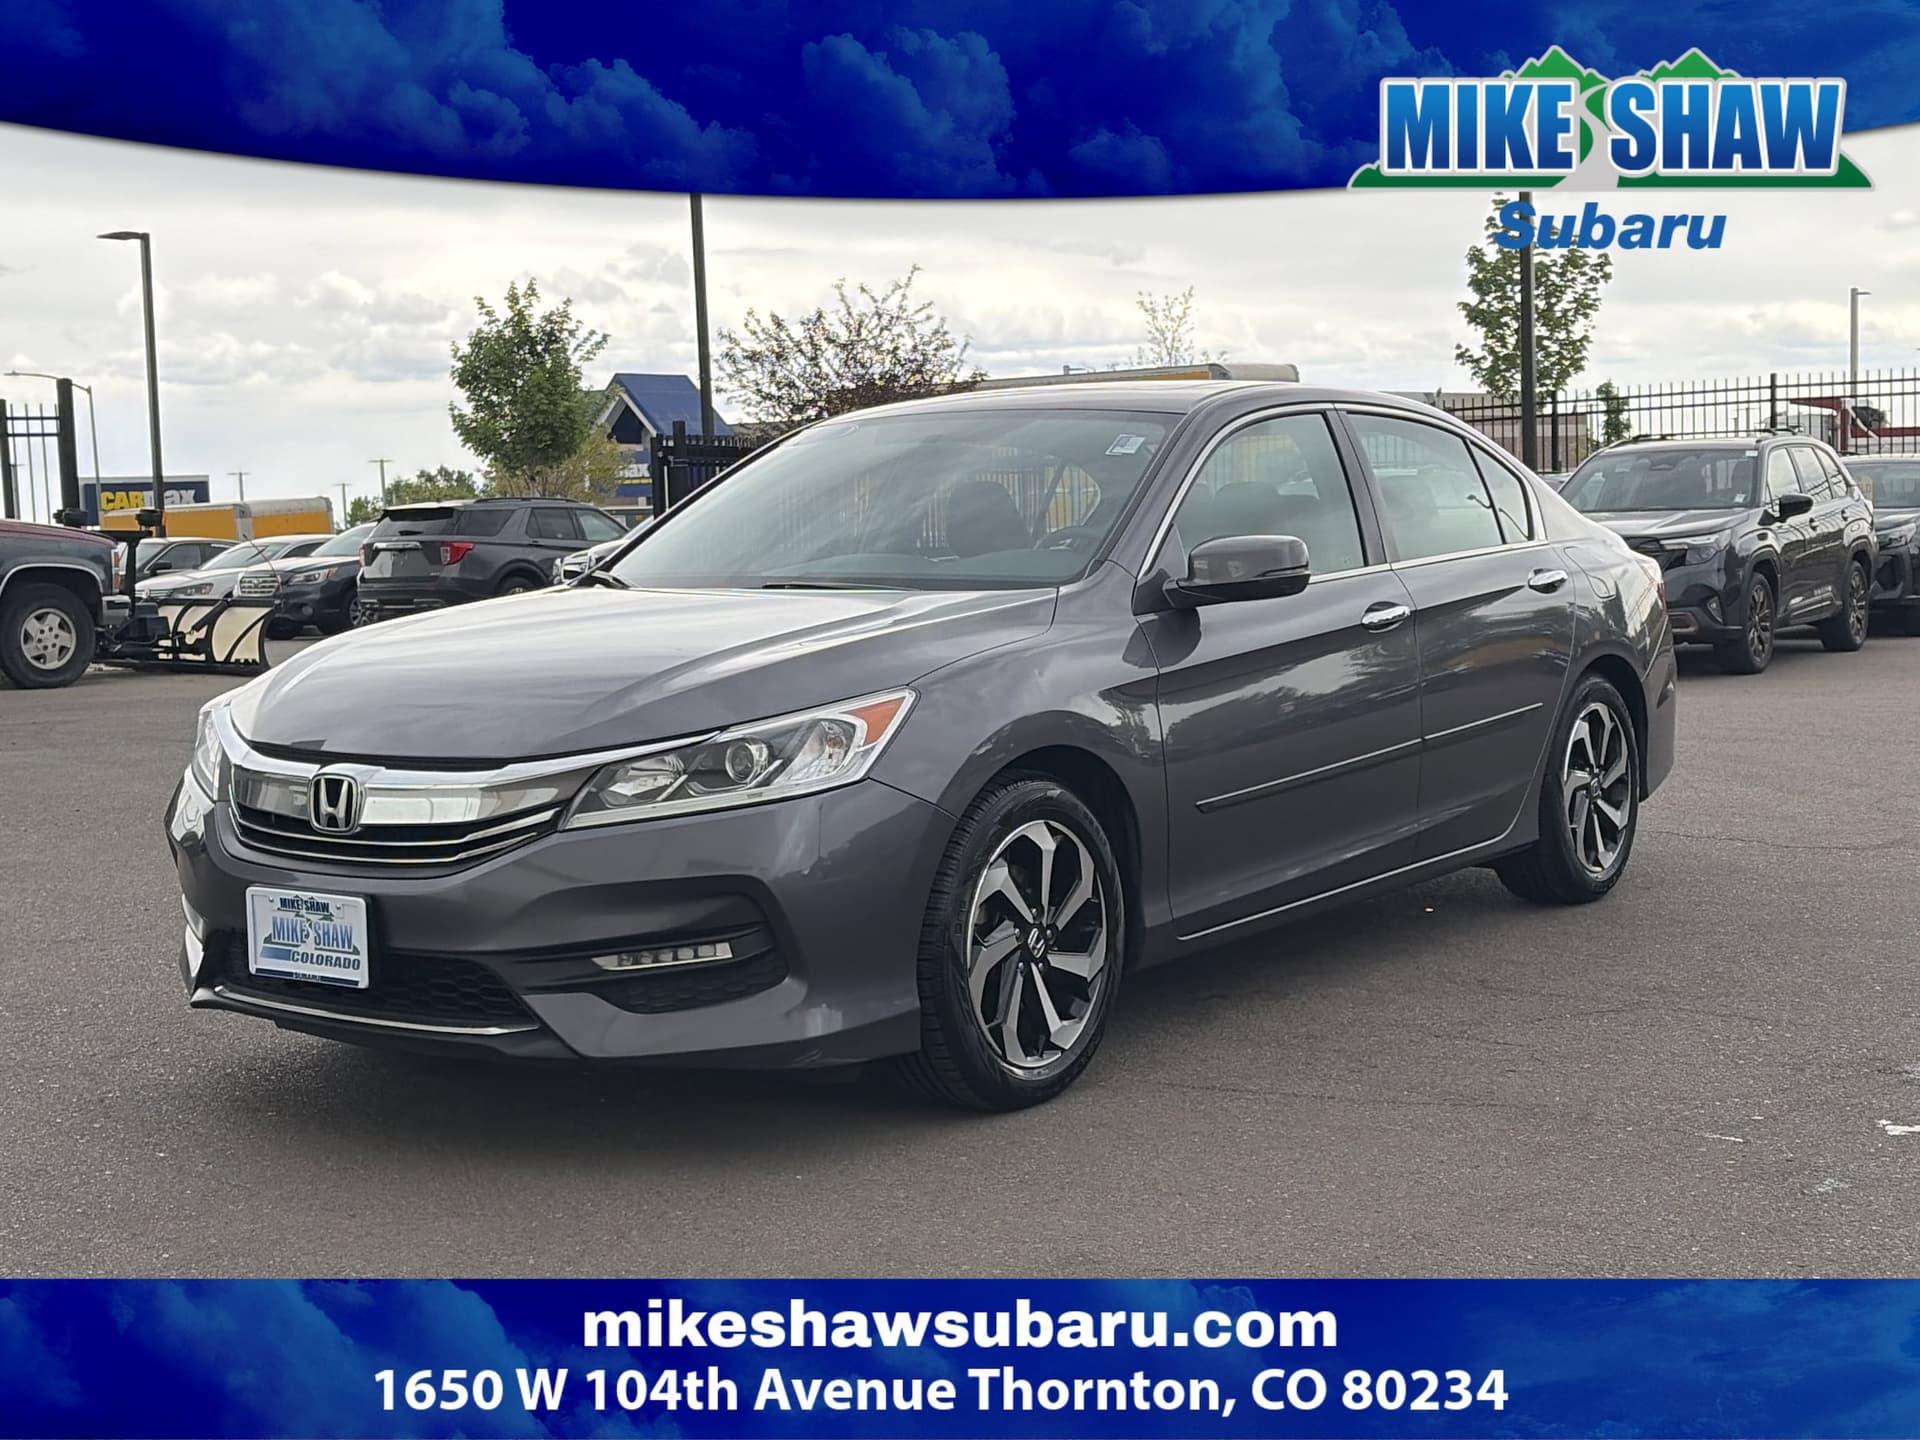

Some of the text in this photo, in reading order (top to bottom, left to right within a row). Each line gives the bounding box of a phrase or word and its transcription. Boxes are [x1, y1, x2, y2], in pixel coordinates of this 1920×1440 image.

[279, 897, 331, 914] MIKE SHAW
[271, 916, 353, 950] MIKE SHAW
[291, 950, 361, 971] COLORADO
